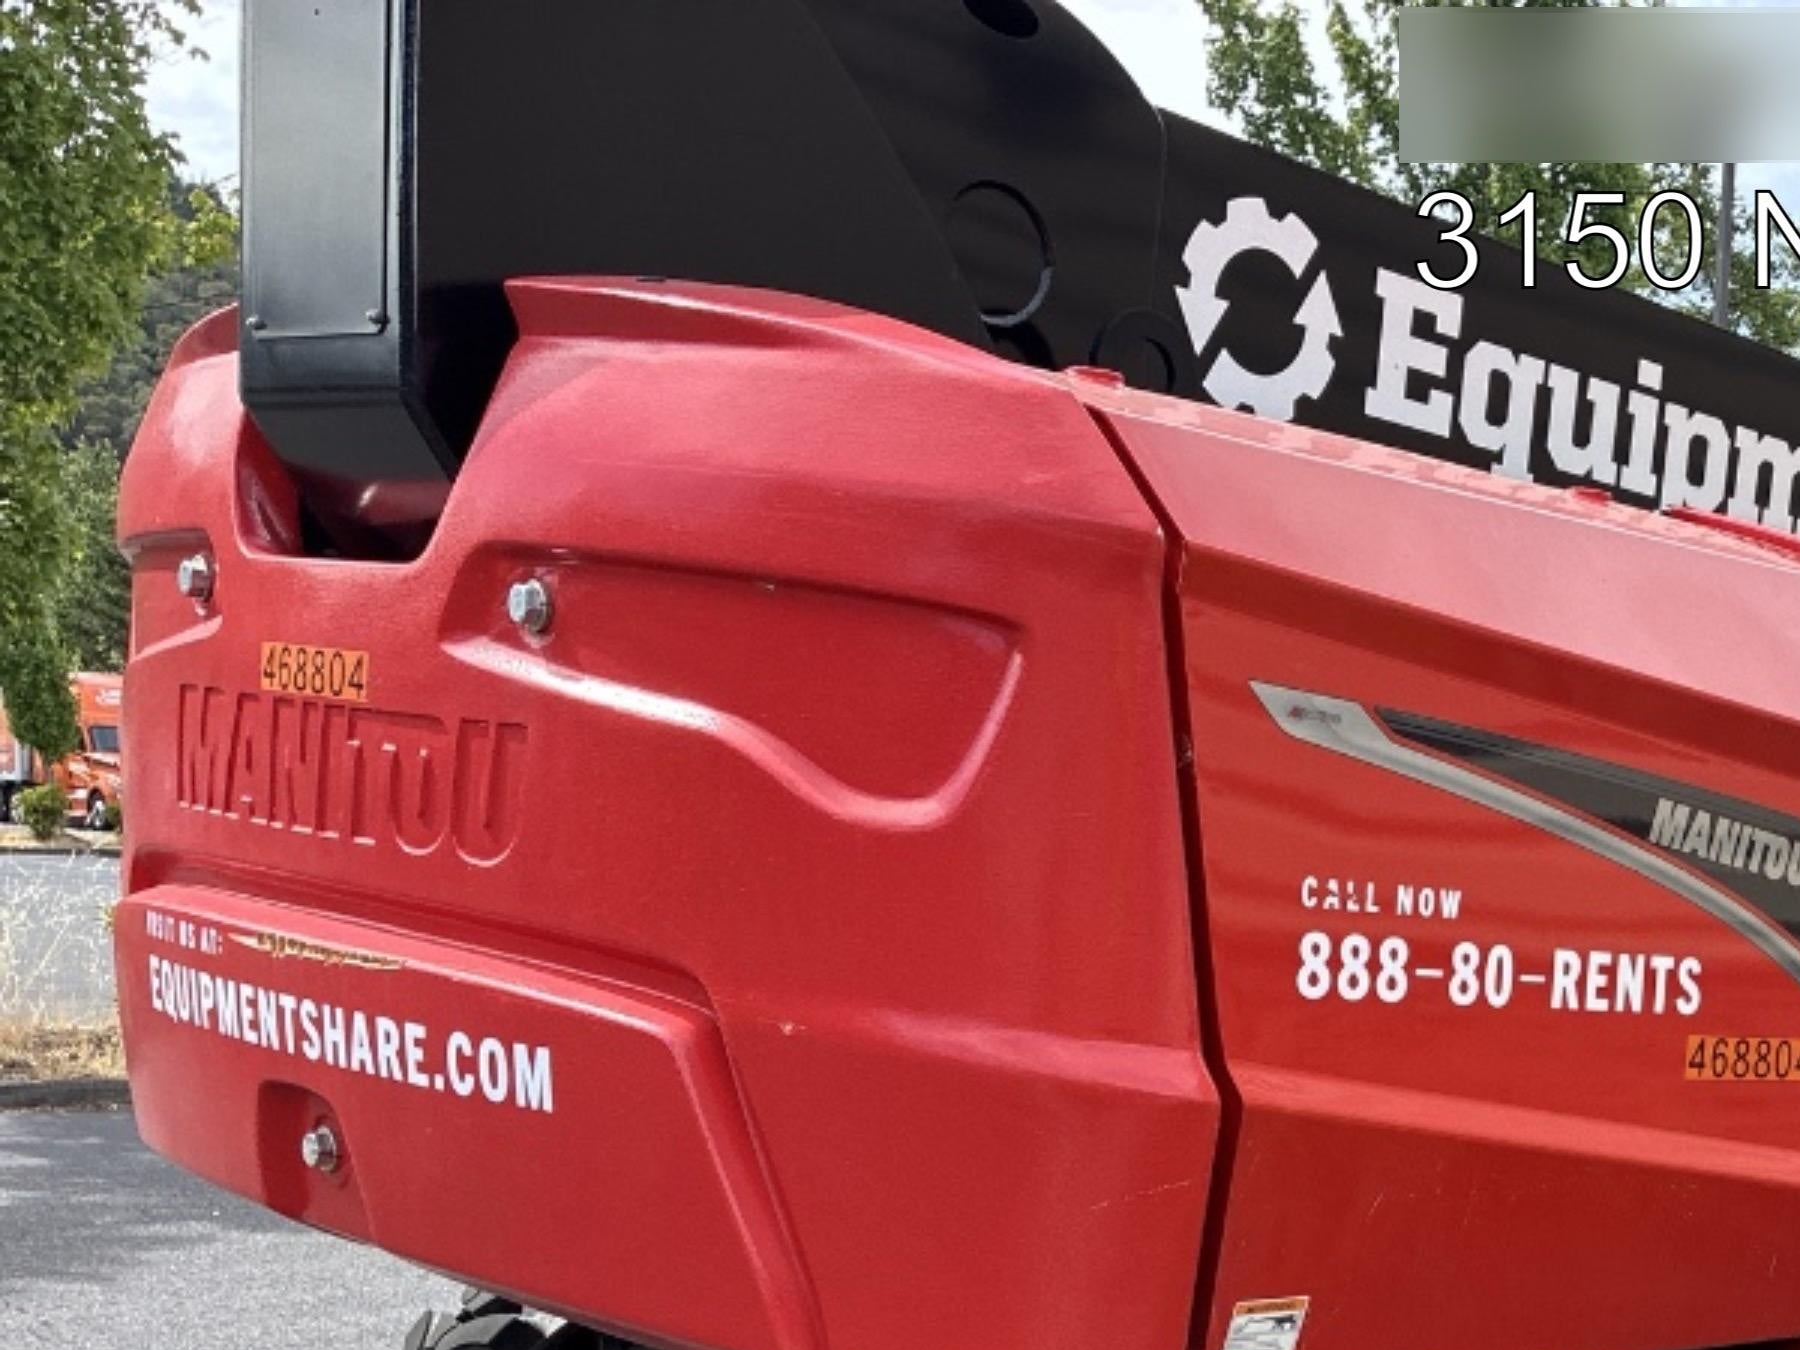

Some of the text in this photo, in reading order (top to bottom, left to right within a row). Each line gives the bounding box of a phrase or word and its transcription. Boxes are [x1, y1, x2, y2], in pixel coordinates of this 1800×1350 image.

[262, 646, 366, 699] 468804
[178, 684, 530, 866] MANITOU
[1301, 876, 1462, 920] CALL NOW
[1296, 931, 1703, 1017] 888-80-RENTS
[149, 955, 555, 1113] EQUIPMENTSHARE.COM
